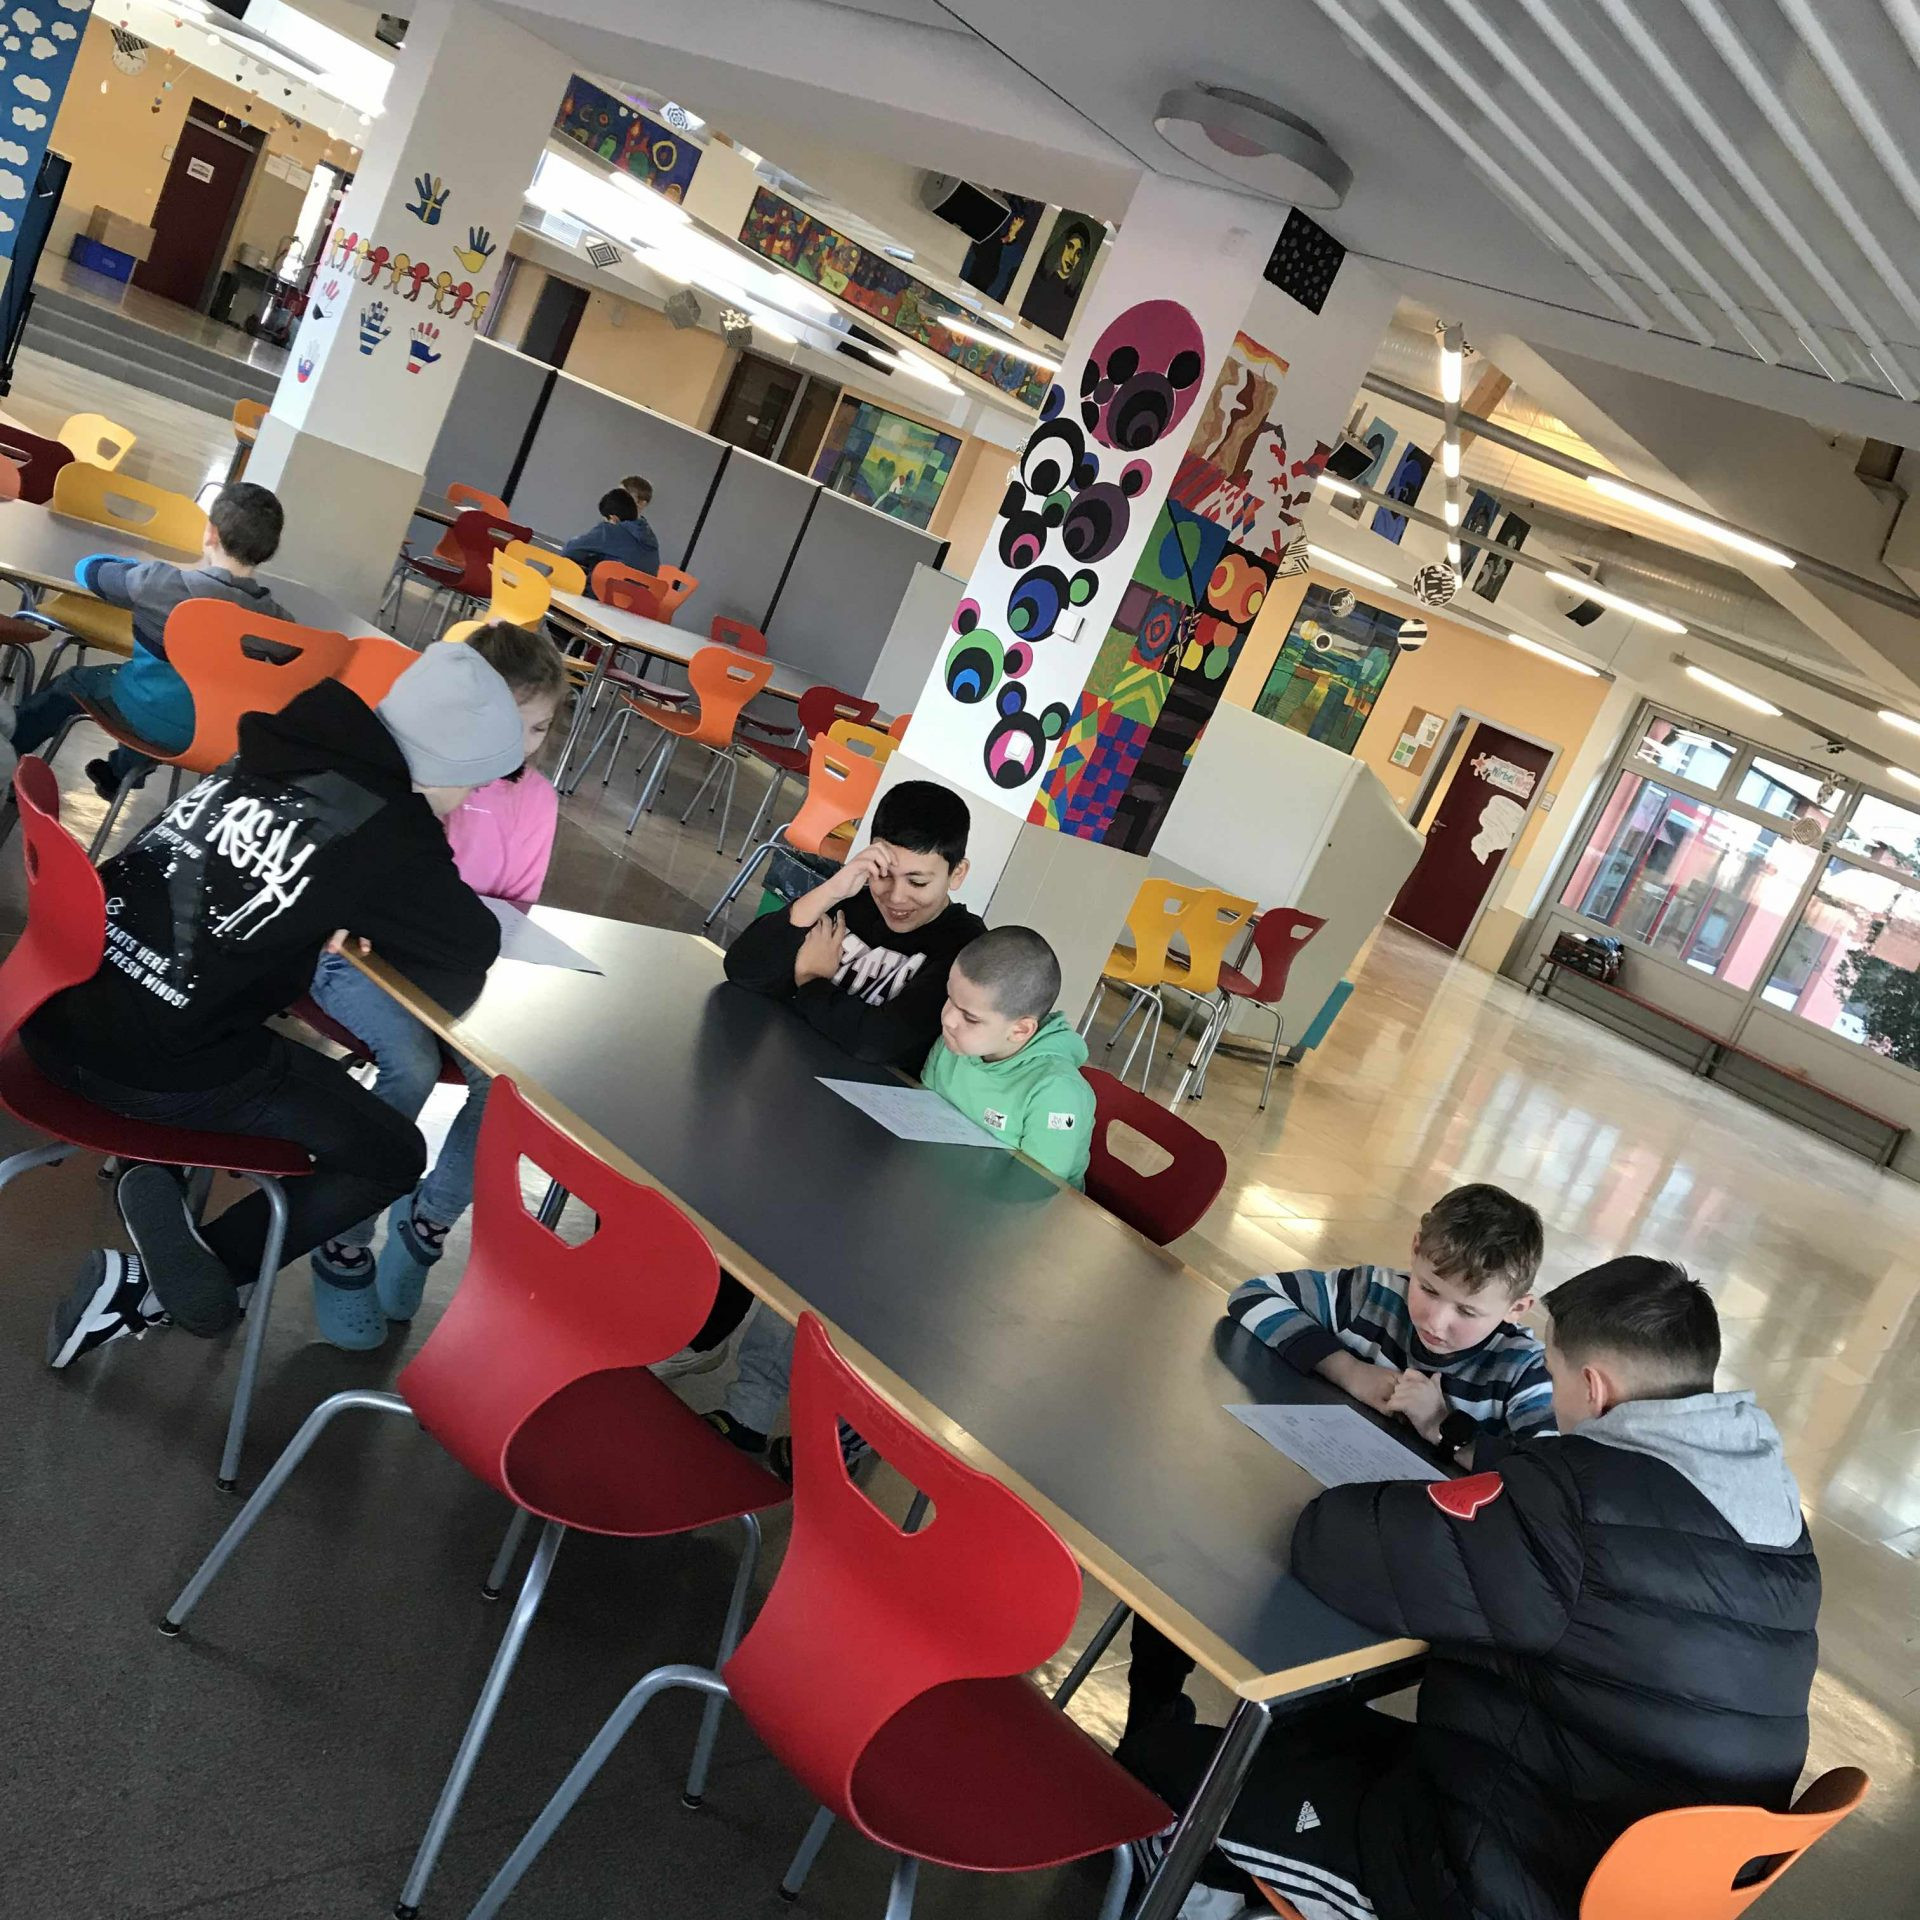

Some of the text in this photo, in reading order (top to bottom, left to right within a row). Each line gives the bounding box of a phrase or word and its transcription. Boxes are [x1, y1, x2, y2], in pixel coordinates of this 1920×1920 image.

[104, 919, 170, 975] TARTS HERE
[103, 946, 190, 1009] FRESH MINDS!
